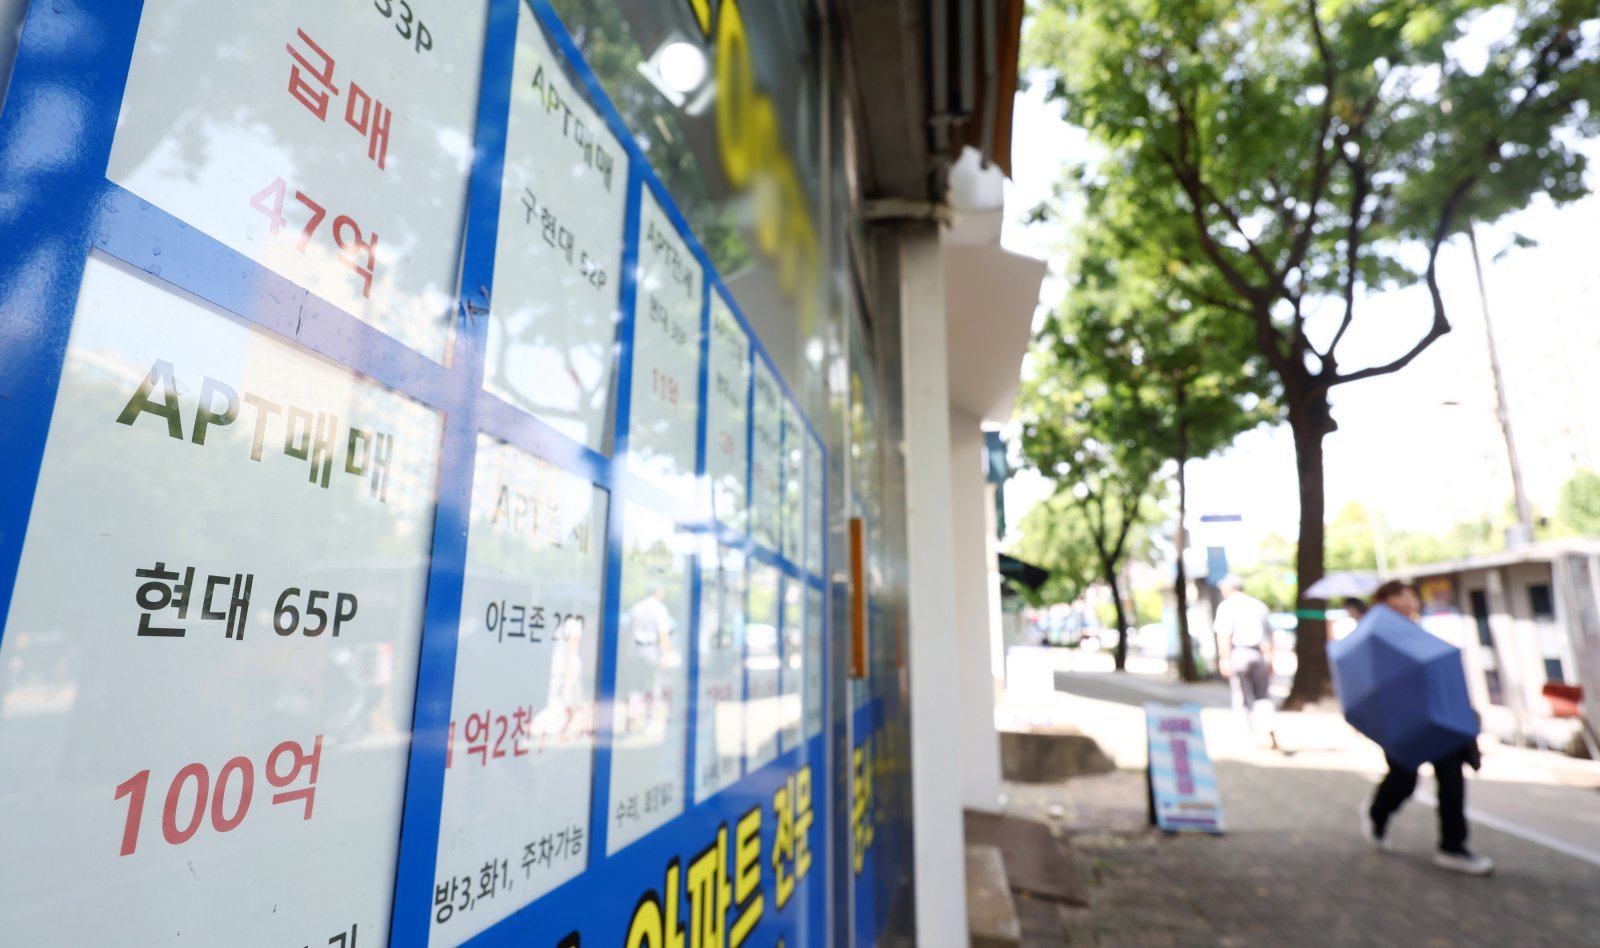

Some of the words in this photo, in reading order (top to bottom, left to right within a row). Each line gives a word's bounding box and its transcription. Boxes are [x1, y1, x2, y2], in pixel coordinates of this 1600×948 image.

[286, 27, 392, 171] 급매
[531, 65, 614, 192] APT매매
[250, 176, 378, 299] 47억
[521, 187, 575, 266] 구현대
[115, 358, 395, 503] APT매매
[135, 562, 254, 641] 현대
[272, 587, 359, 638] 65P
[486, 600, 545, 643] 아크존
[114, 734, 323, 857] 100억
[622, 804, 764, 948] 아파트
[771, 764, 814, 911] 전문
[434, 858, 513, 924] 방3,화1,
[521, 825, 584, 880] 주차가능
